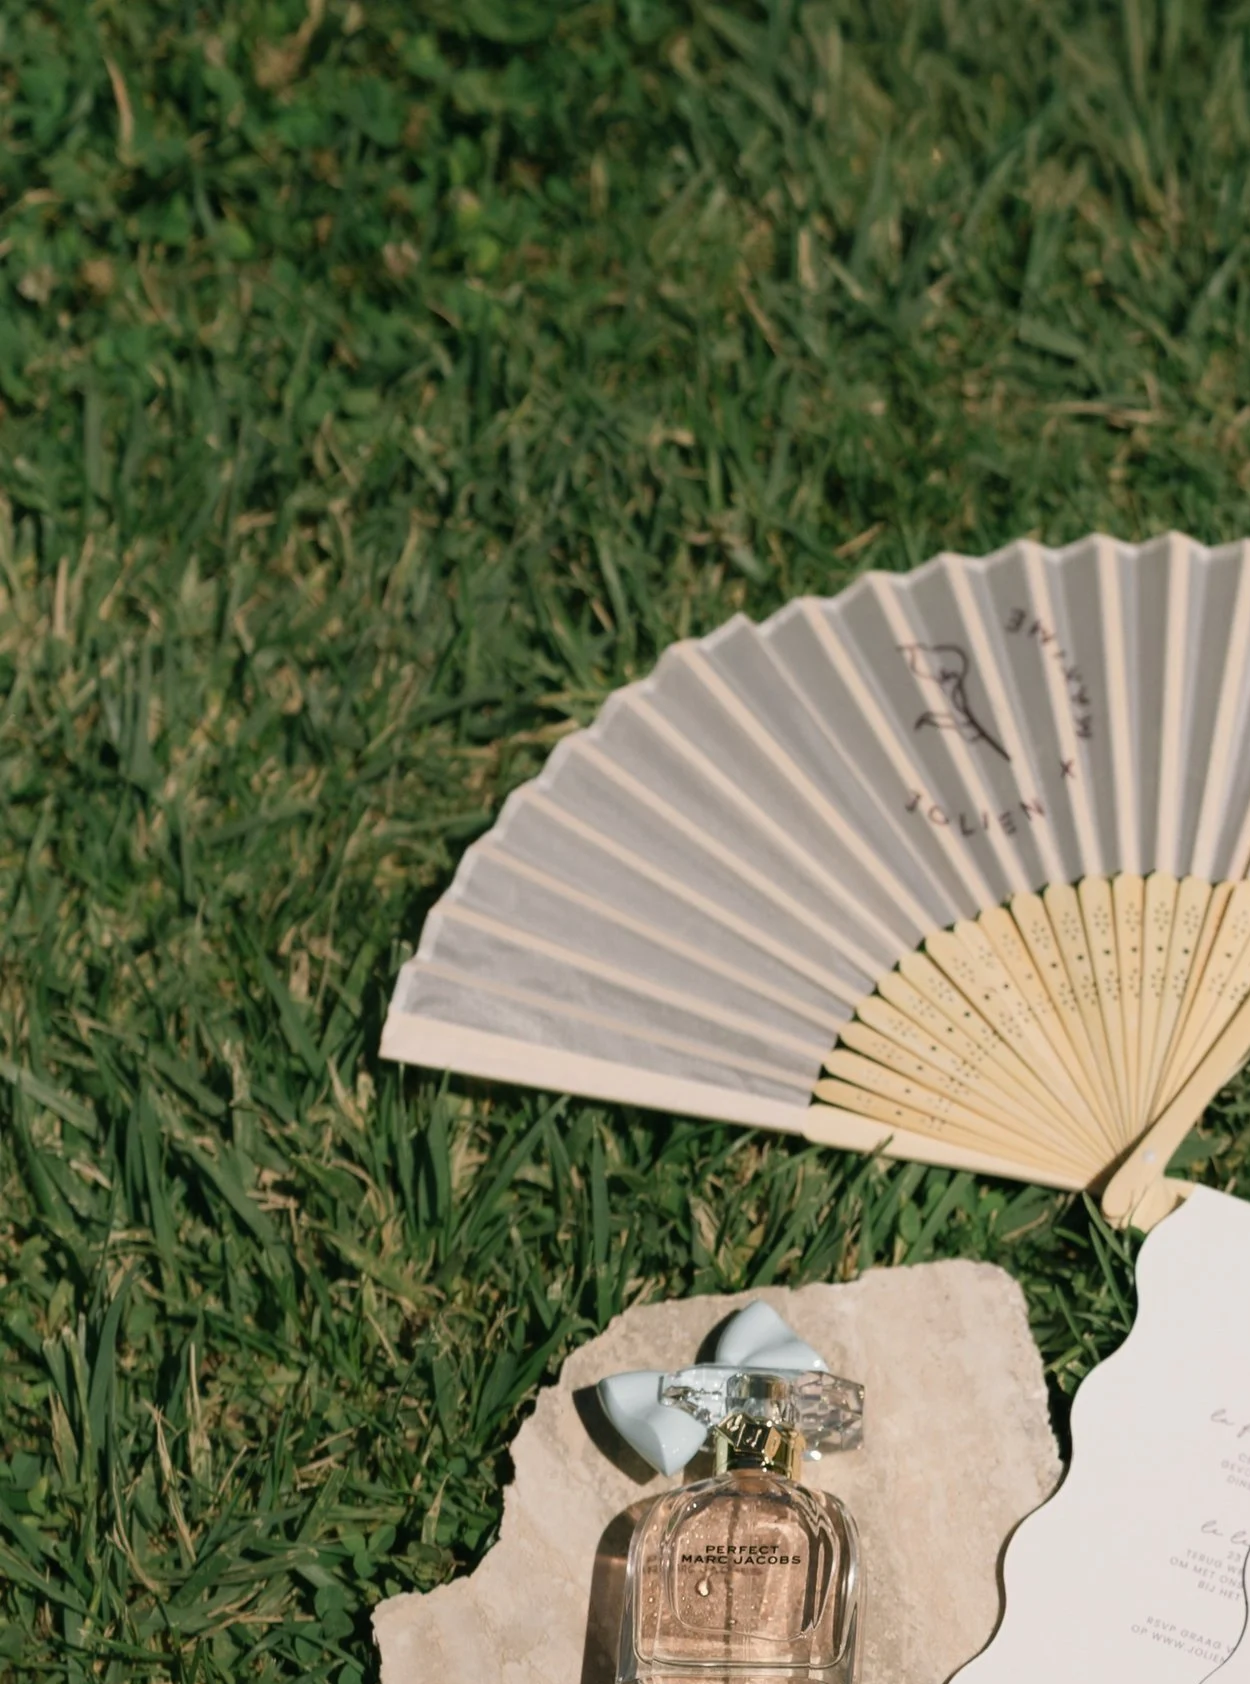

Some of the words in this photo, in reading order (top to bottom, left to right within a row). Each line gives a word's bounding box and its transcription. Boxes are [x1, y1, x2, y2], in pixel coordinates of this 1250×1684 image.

[904, 790, 1046, 836] JOLIEN
[706, 1545, 779, 1556] PERFECT
[1226, 1550, 1242, 1563] 23
[681, 1554, 728, 1565] MARC
[733, 1555, 801, 1566] JACOBS
[1186, 1548, 1223, 1569] TERUG
[1169, 1556, 1189, 1570] OM
[1192, 1564, 1216, 1579] MET
[1197, 1579, 1216, 1593] BIJ
[1130, 1624, 1149, 1636] OP
[1146, 1615, 1177, 1632] RSVP
[1179, 1628, 1222, 1650] GRAAG
